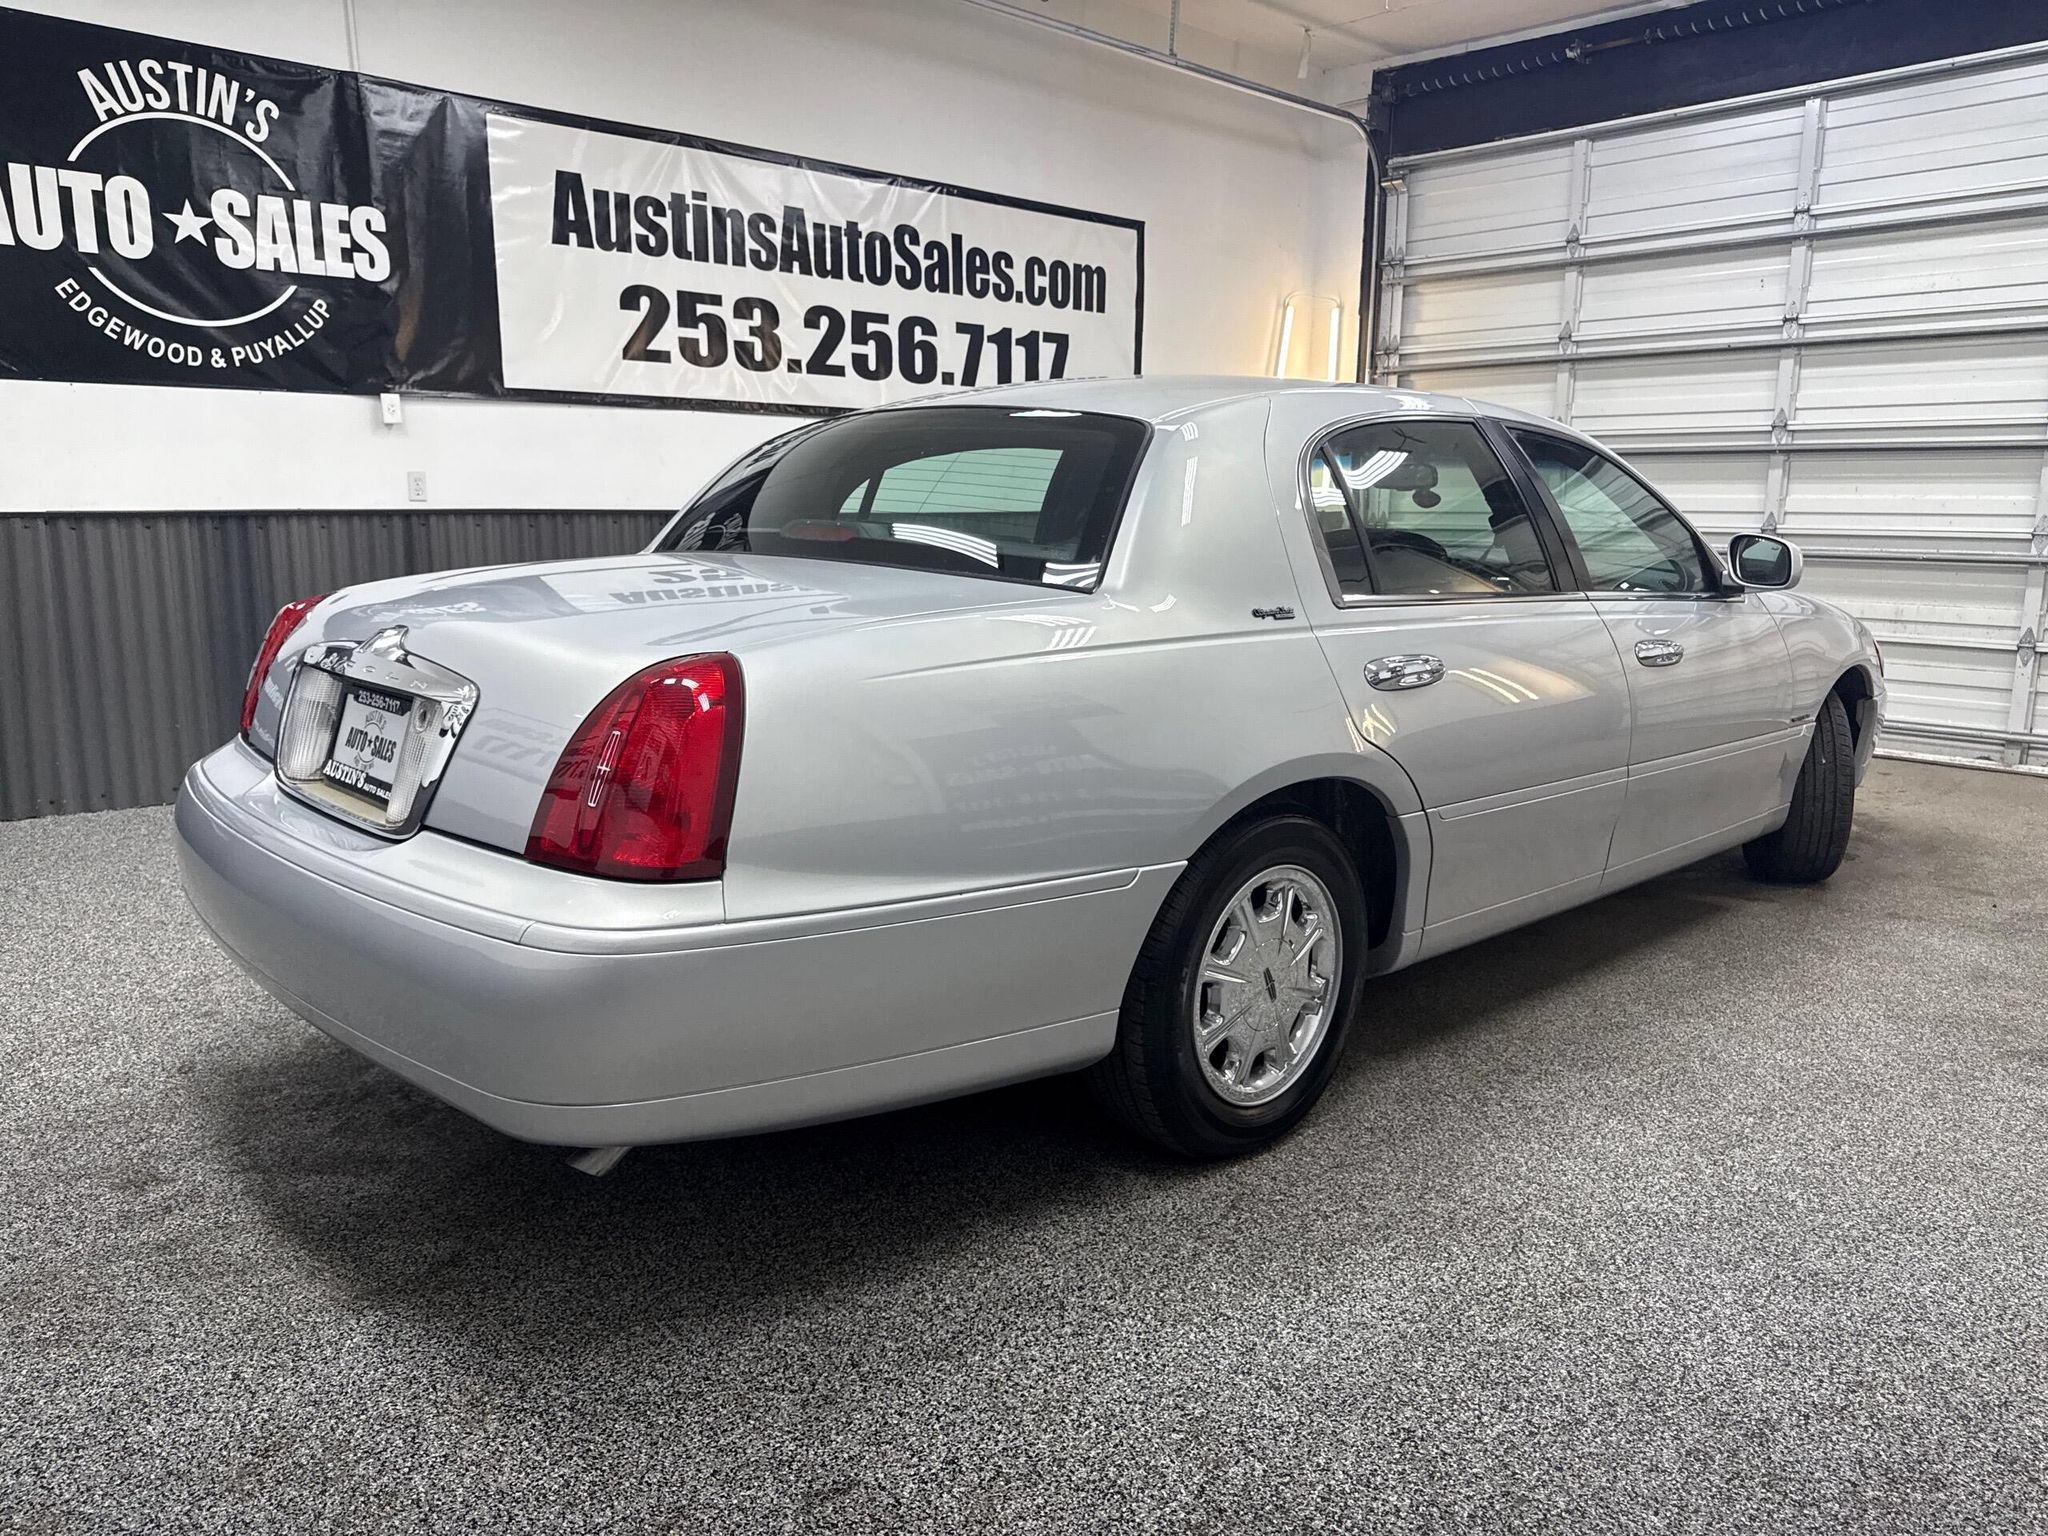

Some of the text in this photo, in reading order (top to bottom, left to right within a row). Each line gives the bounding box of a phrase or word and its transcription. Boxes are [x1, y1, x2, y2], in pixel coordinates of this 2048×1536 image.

[76, 57, 280, 143] AUSTIN'S
[211, 188, 392, 283] SALES
[551, 169, 1107, 314] AustinsAutoSales.com
[54, 277, 332, 369] EDGEWOOD & PUYALLUP
[618, 284, 1070, 388] 253.256.7117
[344, 726, 367, 753] AUTO
[370, 734, 397, 764] SALES
[358, 689, 401, 715] 253-256-7117
[322, 758, 369, 789] AUSTIN'S
[362, 782, 377, 794] AUTO
